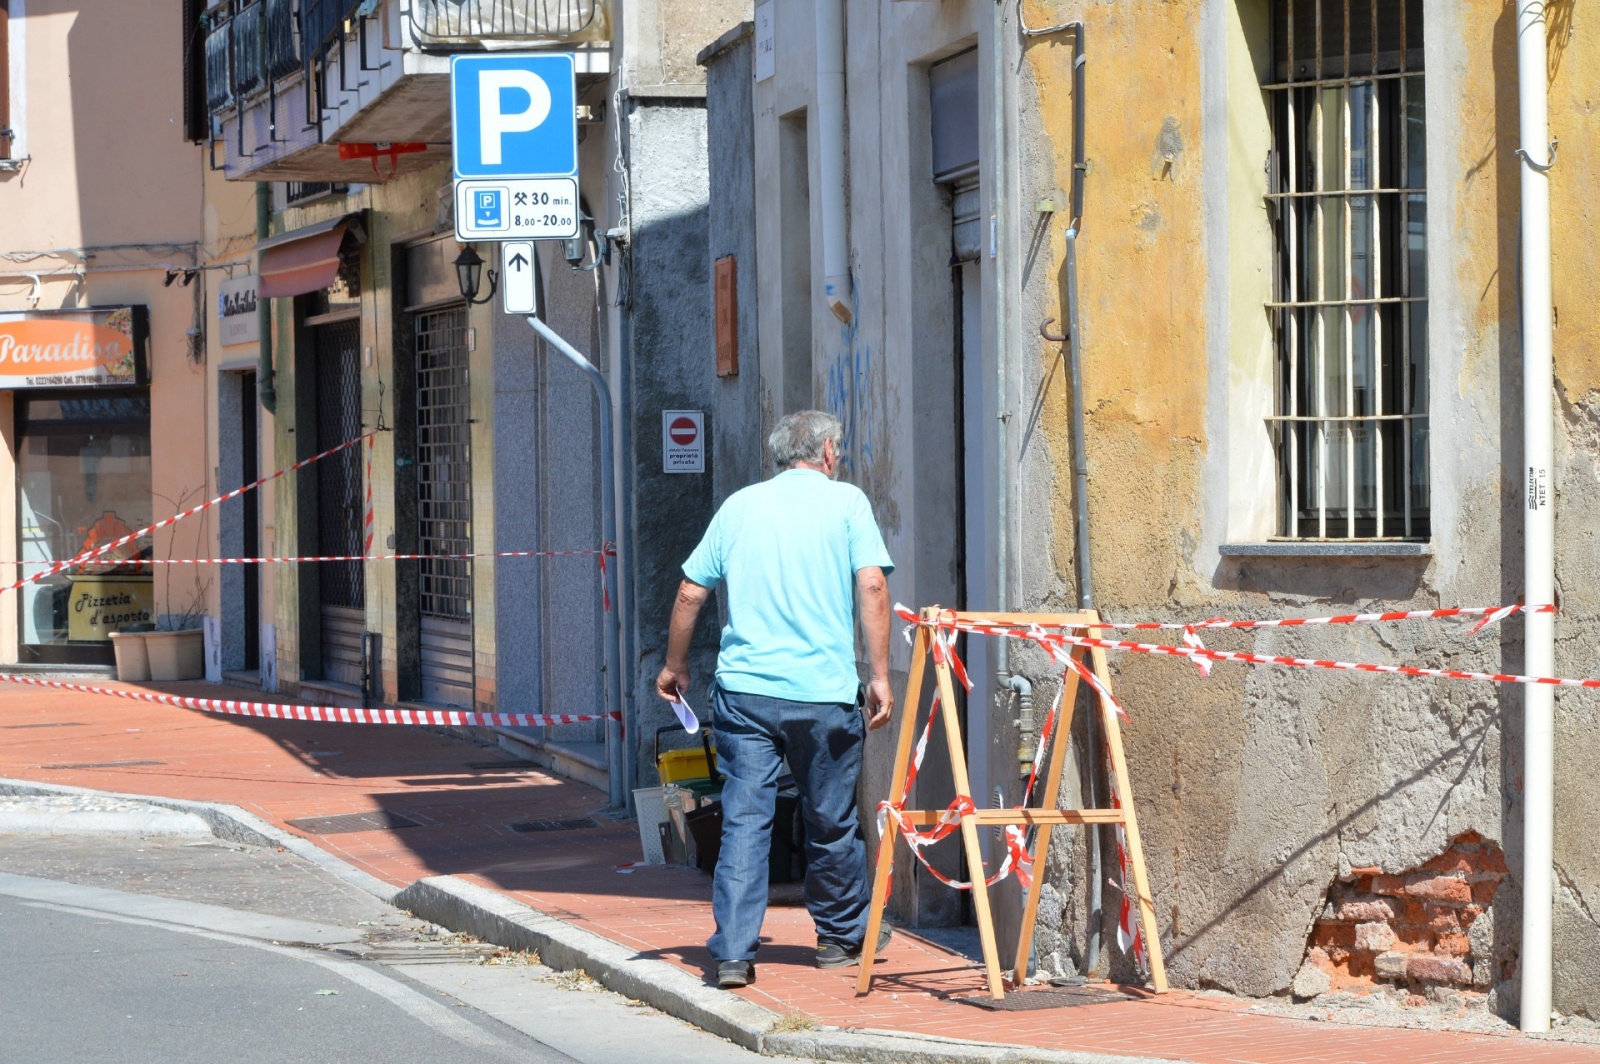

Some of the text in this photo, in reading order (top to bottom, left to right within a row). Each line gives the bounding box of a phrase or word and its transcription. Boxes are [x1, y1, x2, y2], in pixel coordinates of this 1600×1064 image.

[479, 69, 551, 165] P
[483, 195, 492, 207] P
[531, 191, 572, 206] 30 min.
[0, 331, 120, 363] Paradiso
[75, 592, 132, 612] Pizzeria
[90, 609, 150, 630] d'asporto
